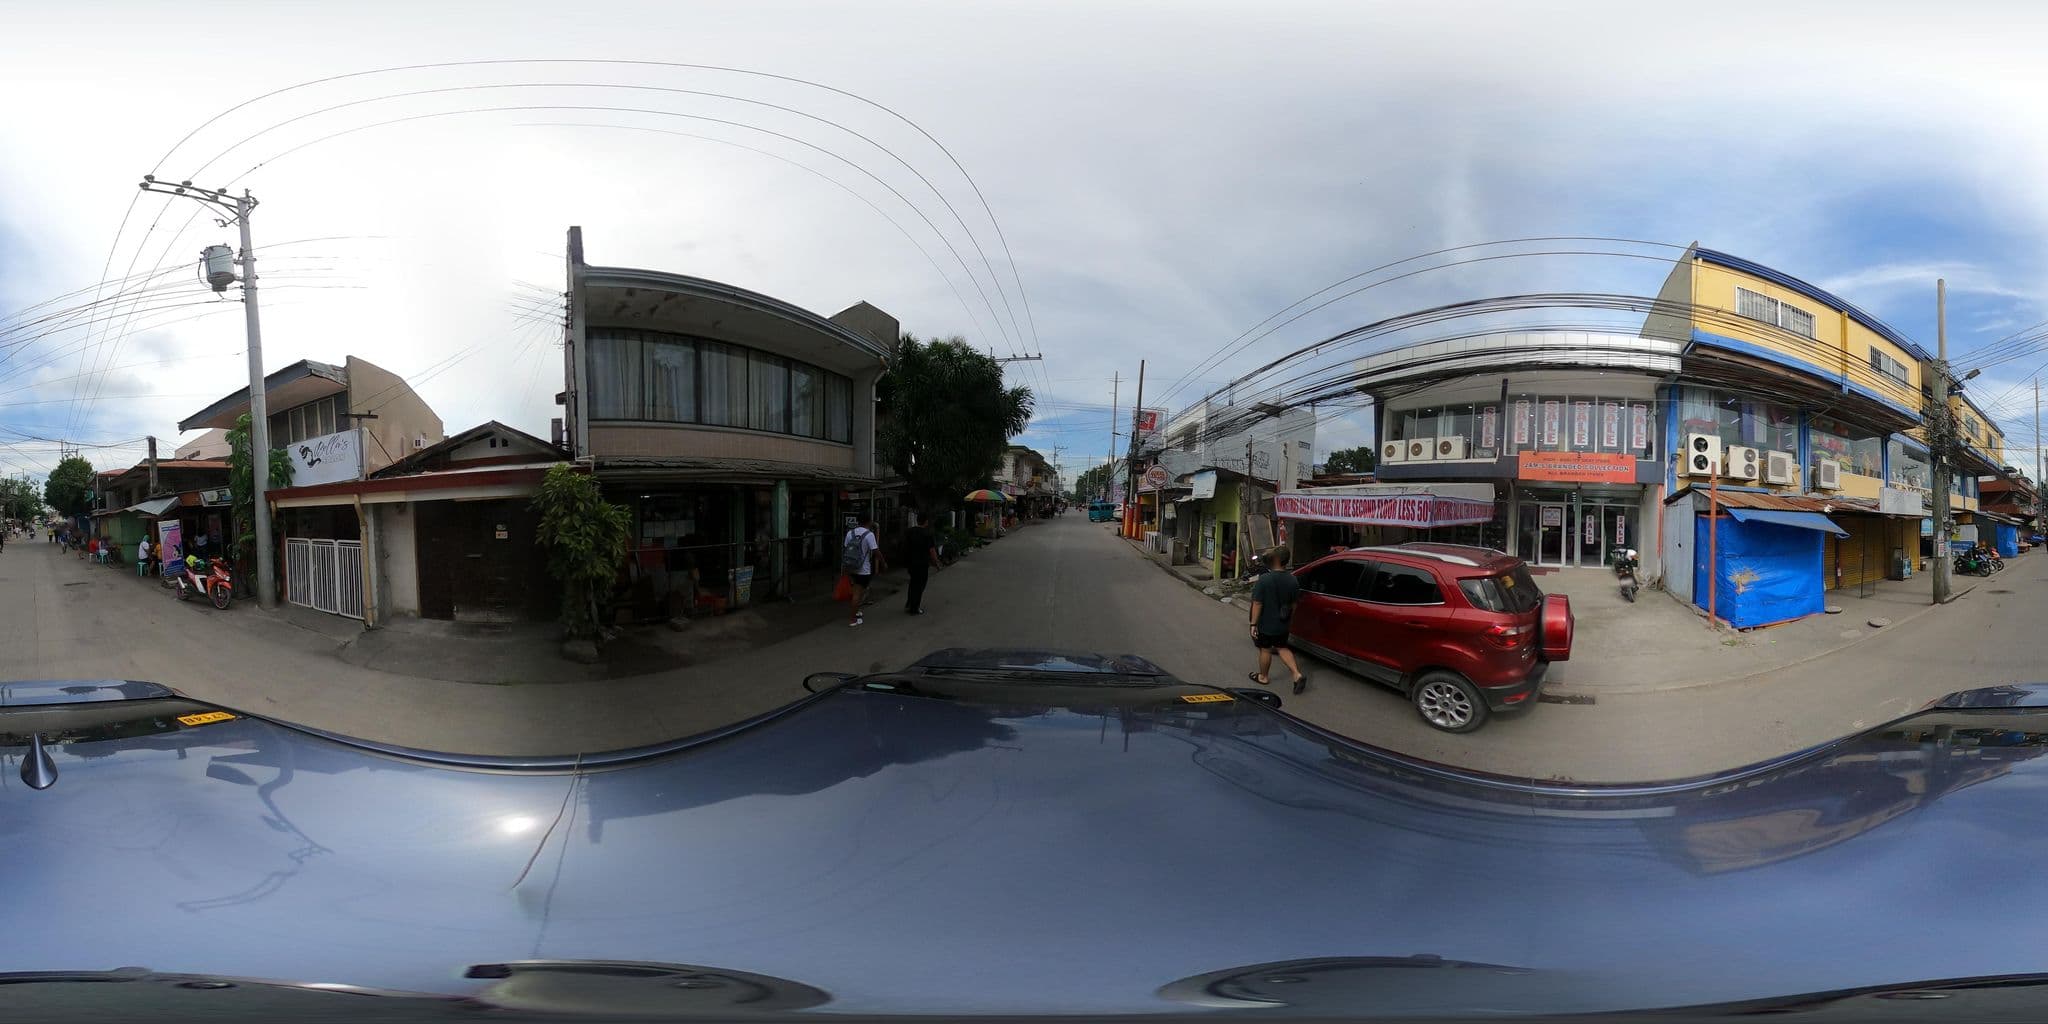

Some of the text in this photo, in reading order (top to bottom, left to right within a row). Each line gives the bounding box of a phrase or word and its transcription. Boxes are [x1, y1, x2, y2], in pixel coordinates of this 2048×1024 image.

[1484, 408, 1495, 446] SALE
[1516, 401, 1528, 442] SALE
[1545, 401, 1558, 443] SALE
[1575, 402, 1588, 444] SALE
[1604, 403, 1617, 445] SALE
[1633, 405, 1645, 447] SALE
[1584, 464, 1629, 472] COLLECTION
[1310, 499, 1318, 516] ALL
[1319, 499, 1333, 517] ITEMS
[1334, 499, 1340, 517] IN
[1341, 499, 1351, 518] THE
[1352, 499, 1376, 518] SECOND
[1377, 499, 1397, 520] FLOOR
[1398, 499, 1416, 522] LESS
